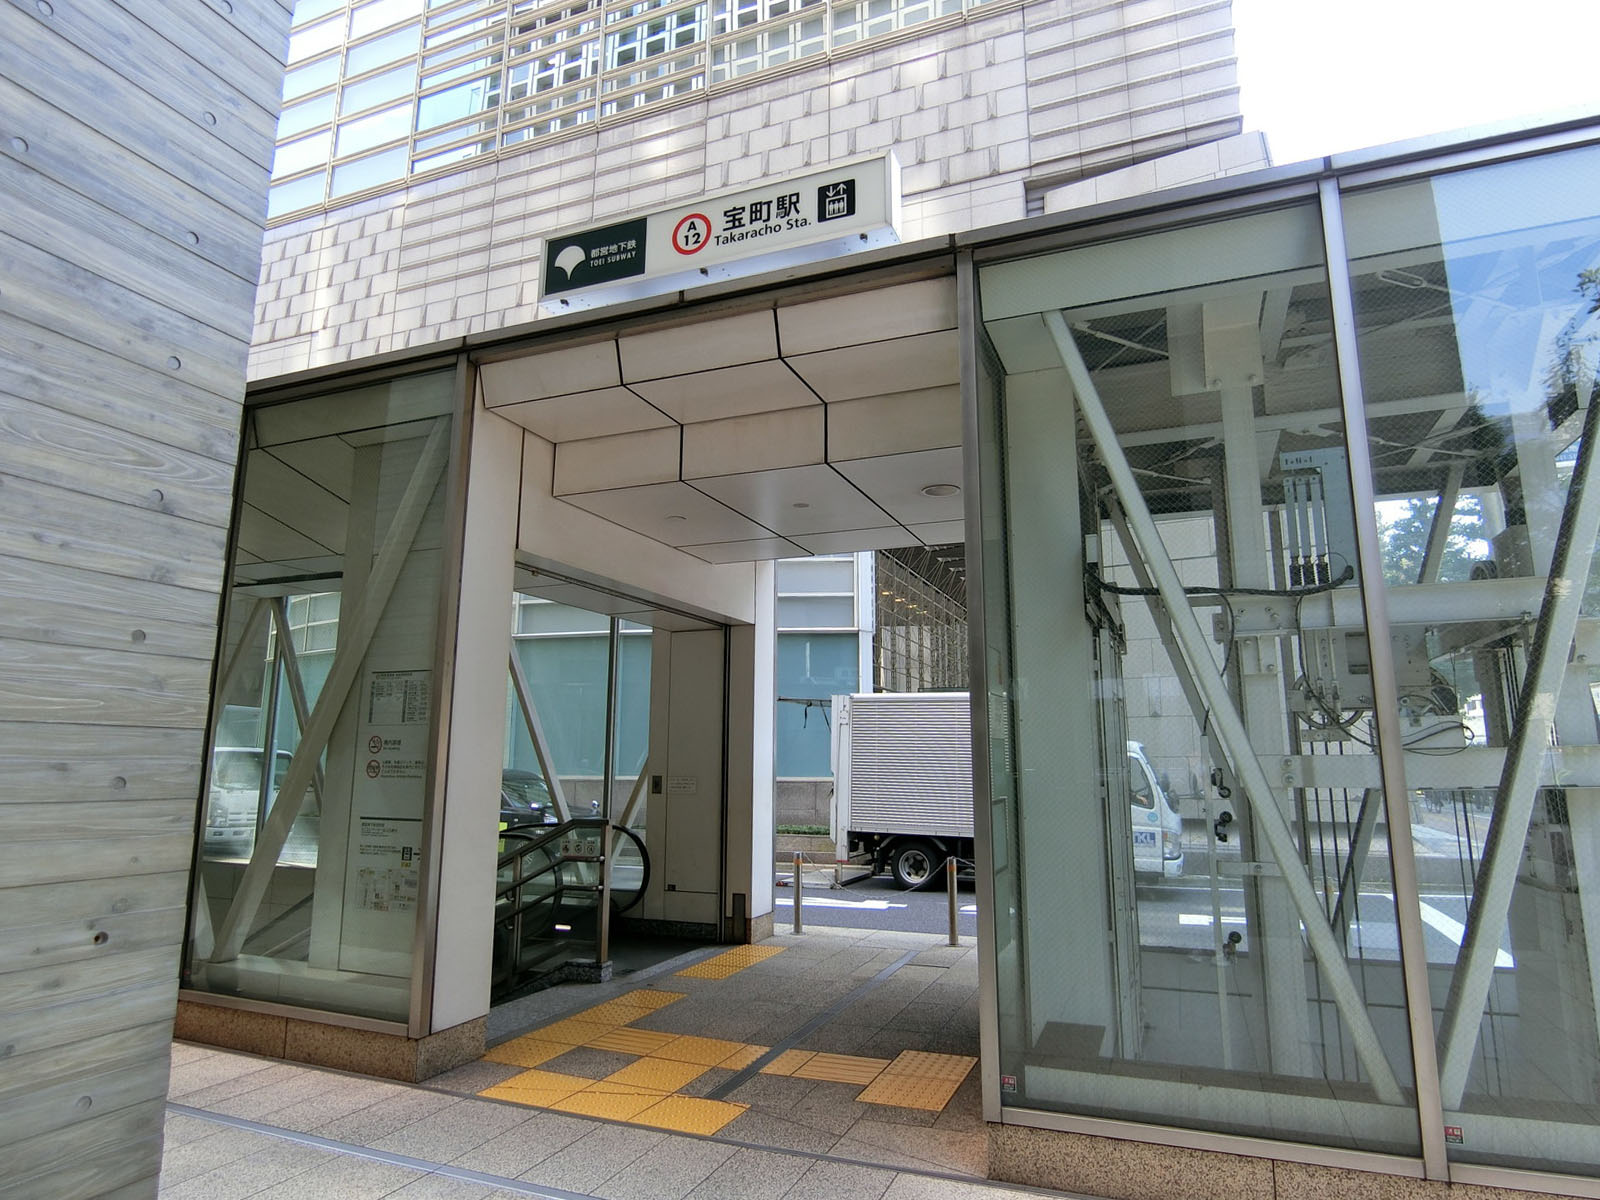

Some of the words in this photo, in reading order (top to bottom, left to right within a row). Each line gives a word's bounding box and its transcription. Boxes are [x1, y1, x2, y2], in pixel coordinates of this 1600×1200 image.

[722, 192, 800, 231] 宝町駅
[687, 220, 697, 232] A
[714, 223, 782, 246] Takaracho
[786, 217, 812, 231] Sta.
[684, 232, 701, 246] 12
[591, 239, 637, 258] 都営地下鉄
[590, 257, 605, 267] TOEI
[607, 250, 636, 262] SUBWAY
